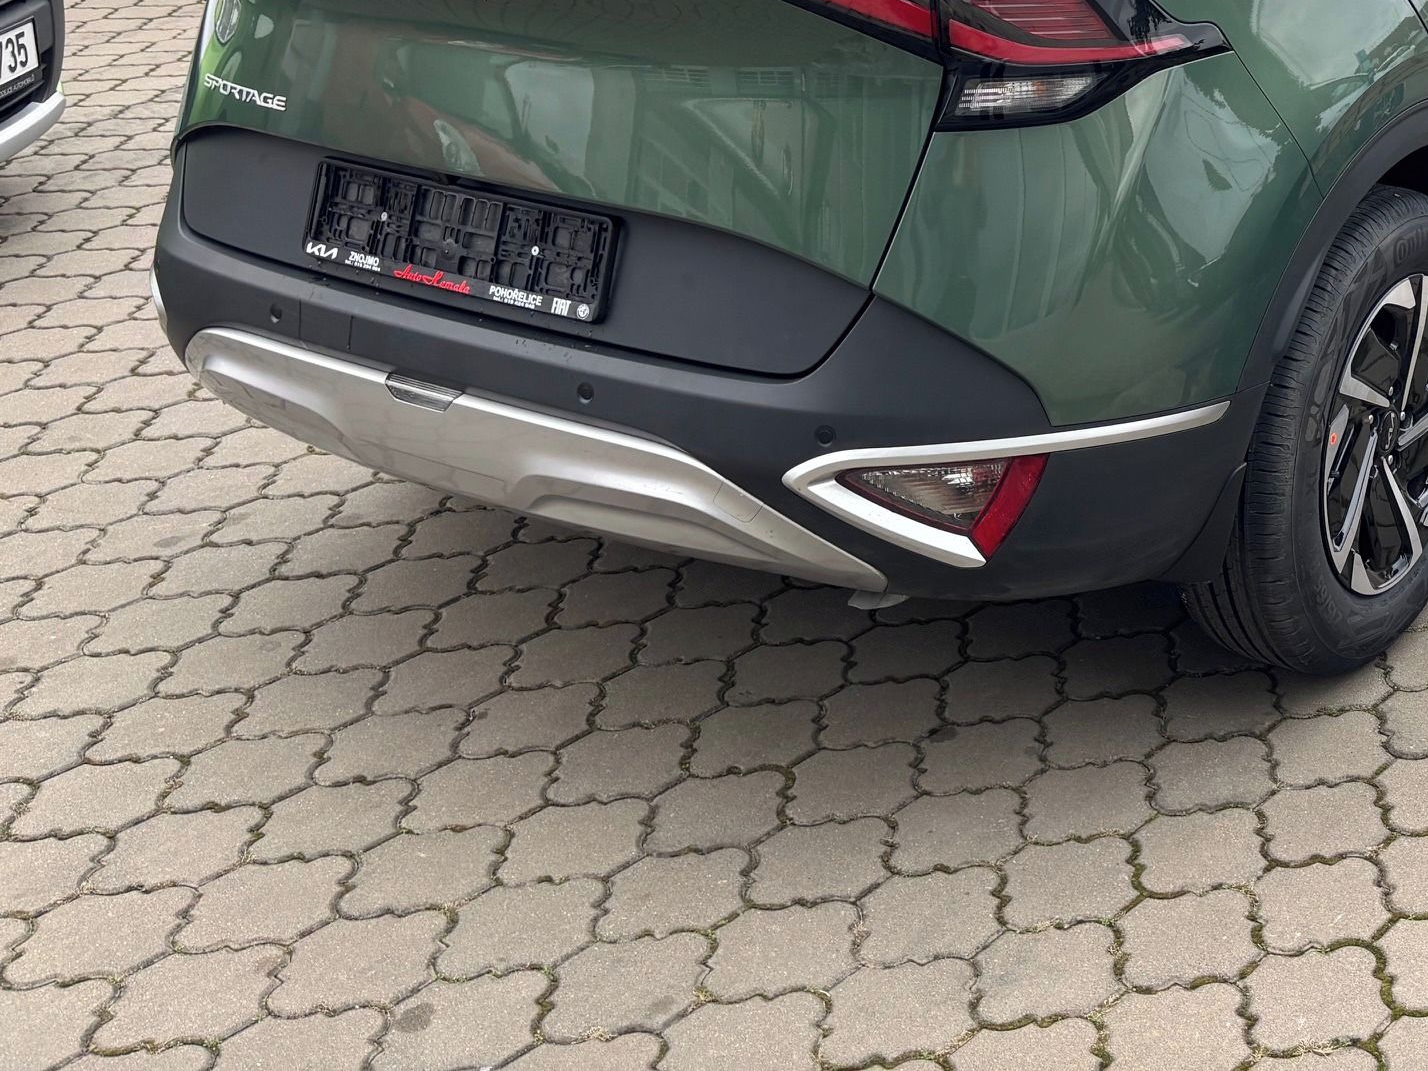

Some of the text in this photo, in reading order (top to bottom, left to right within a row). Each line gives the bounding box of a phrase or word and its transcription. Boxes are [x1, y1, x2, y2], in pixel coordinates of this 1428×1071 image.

[203, 72, 287, 111] SPORTAGE
[306, 241, 339, 260] KIA
[348, 250, 380, 266] ZNOJMO
[392, 263, 422, 281] Auto
[488, 285, 543, 306] POHOŘELICE
[550, 297, 572, 317] FIAT
